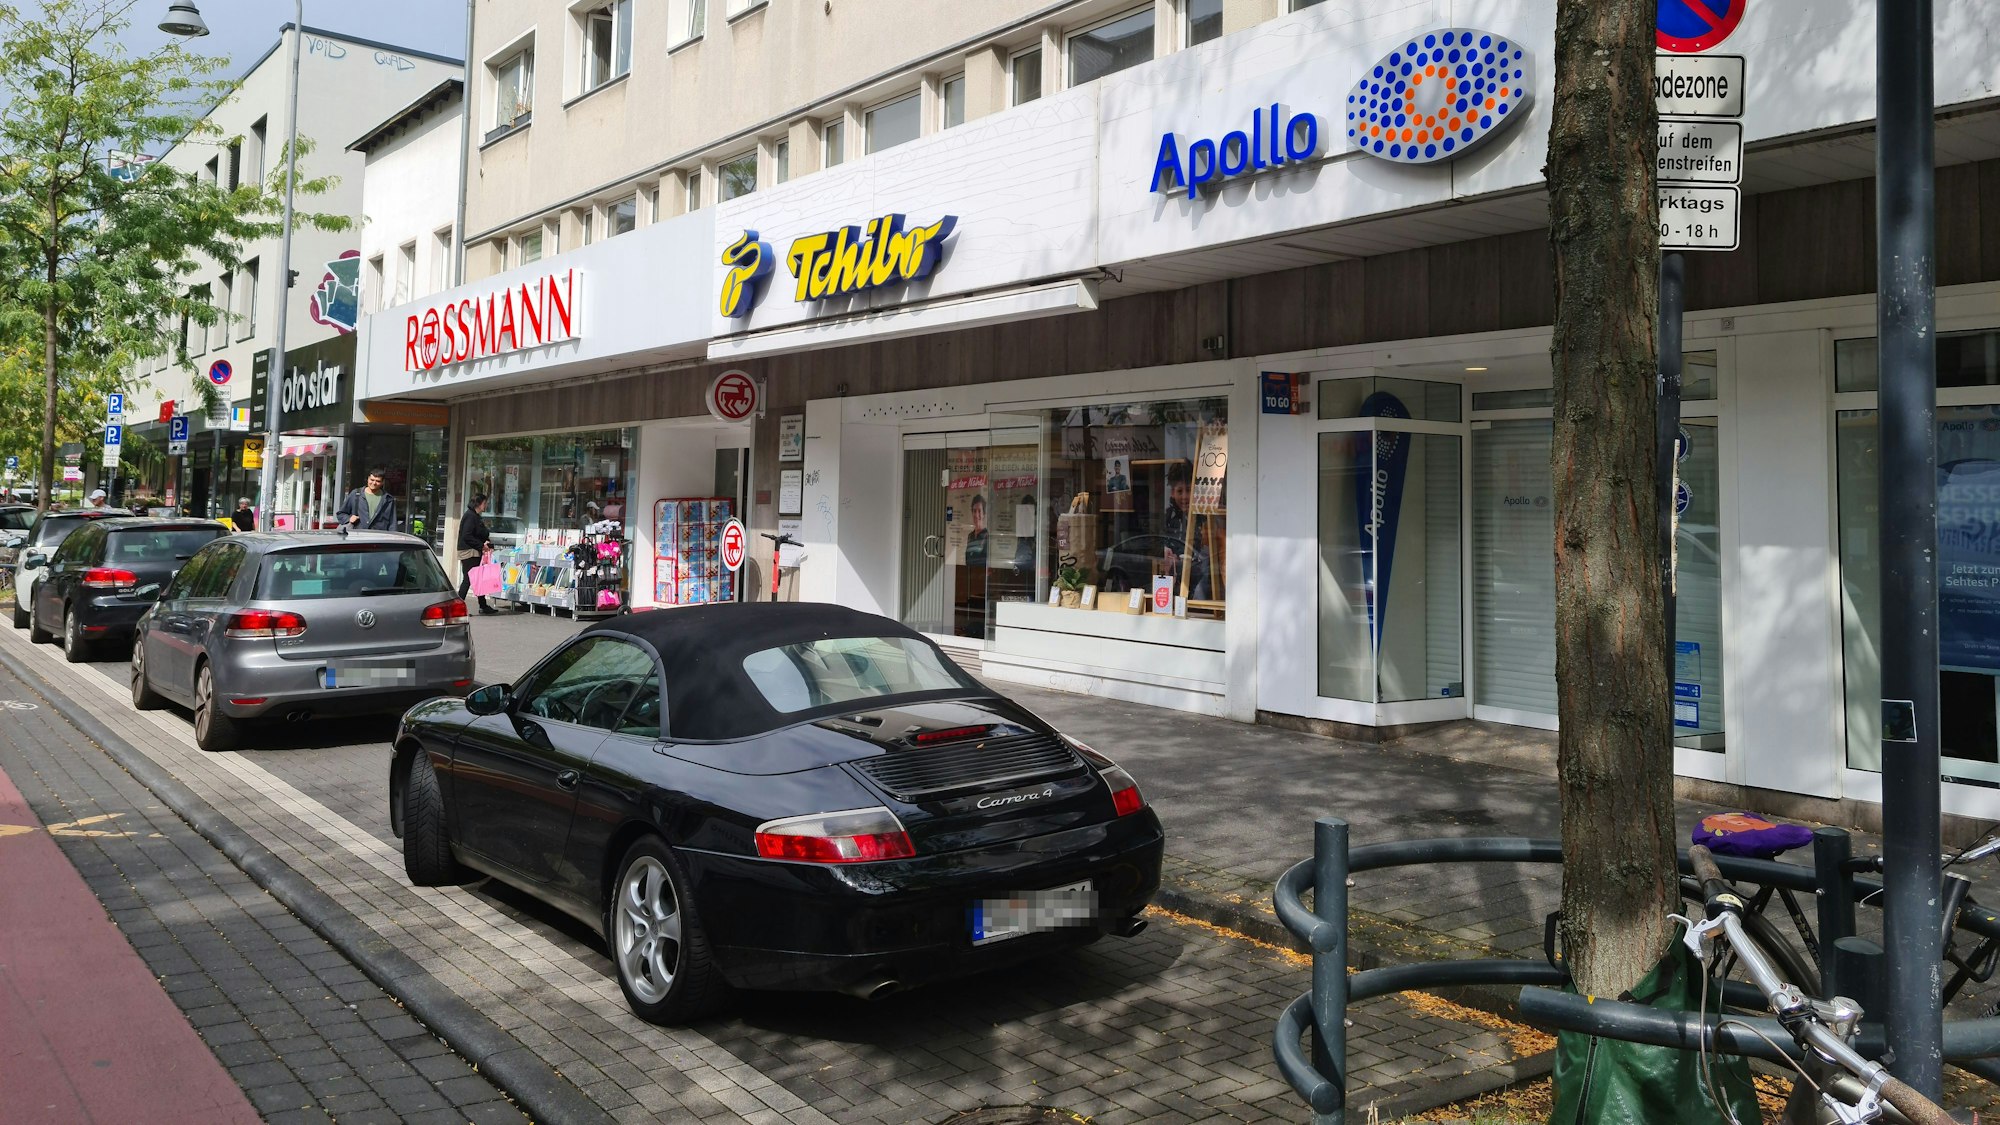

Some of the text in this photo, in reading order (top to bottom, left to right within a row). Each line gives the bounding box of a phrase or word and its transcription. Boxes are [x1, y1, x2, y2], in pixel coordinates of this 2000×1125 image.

[1655, 70, 1728, 99] adezone
[1659, 133, 1713, 149] uf dem
[1150, 102, 1318, 200] Apollo
[1658, 155, 1731, 172] enstreifen
[1659, 195, 1725, 213] rktags
[1661, 223, 1669, 237] 0
[1686, 224, 1703, 238] 18
[1709, 224, 1718, 238] h
[786, 213, 957, 302] Tchibo
[405, 268, 573, 371] ROSSMANN
[282, 366, 307, 414] oto
[308, 360, 341, 409] star
[110, 396, 119, 412] P
[1266, 396, 1289, 408] TO GO
[107, 427, 117, 443] P
[172, 419, 183, 438] P
[1942, 421, 1974, 432] Apollo
[1200, 452, 1227, 467] 100
[1364, 469, 1389, 540] Apollo
[1503, 496, 1530, 506] Apollo
[1938, 507, 2000, 524] SEHE
[1952, 564, 1979, 575] Jetzt
[1945, 576, 2000, 588] Sehtest P
[976, 788, 1053, 810] Carrera 4
